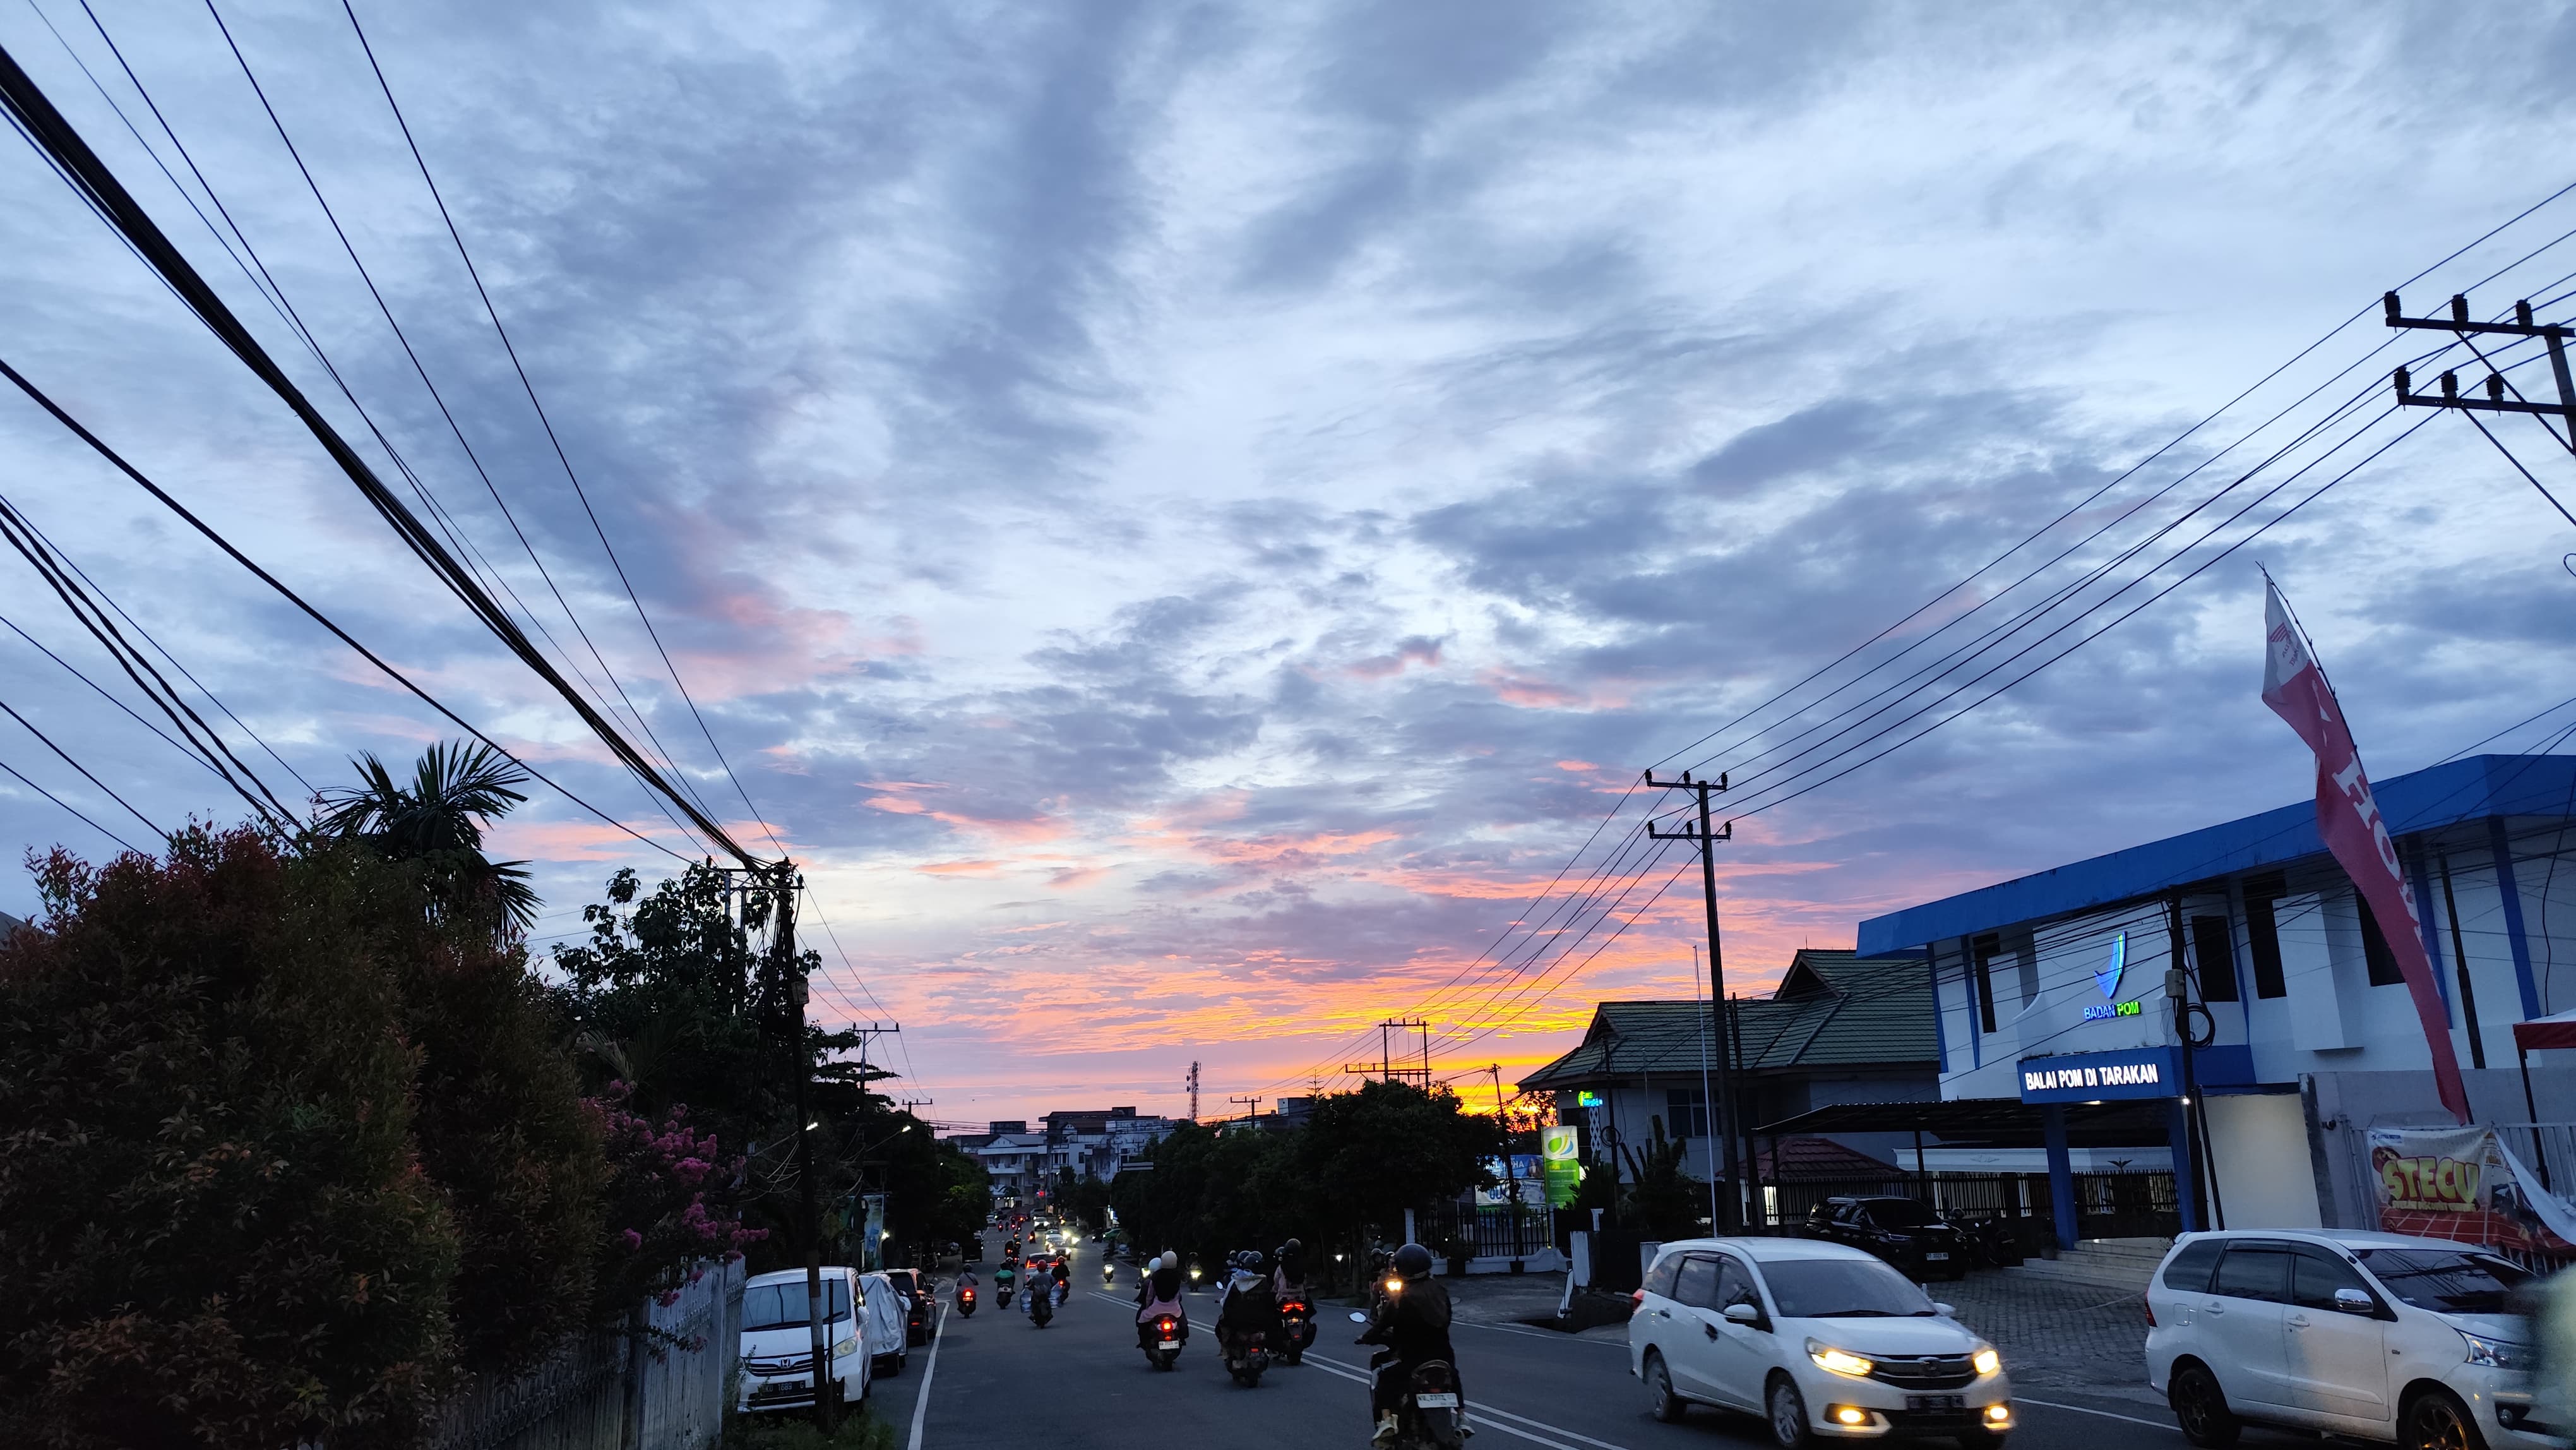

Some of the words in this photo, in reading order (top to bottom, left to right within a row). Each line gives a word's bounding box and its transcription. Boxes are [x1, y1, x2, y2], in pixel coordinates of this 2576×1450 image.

[2084, 1004, 2116, 1019] BADAN
[2116, 1001, 2140, 1016] POM
[2025, 1070, 2058, 1091] BALAI
[2058, 1069, 2084, 1088] POM
[2084, 1067, 2098, 1087] DI
[2099, 1064, 2159, 1086] TARAKAN
[2382, 1156, 2480, 1203] STECU
